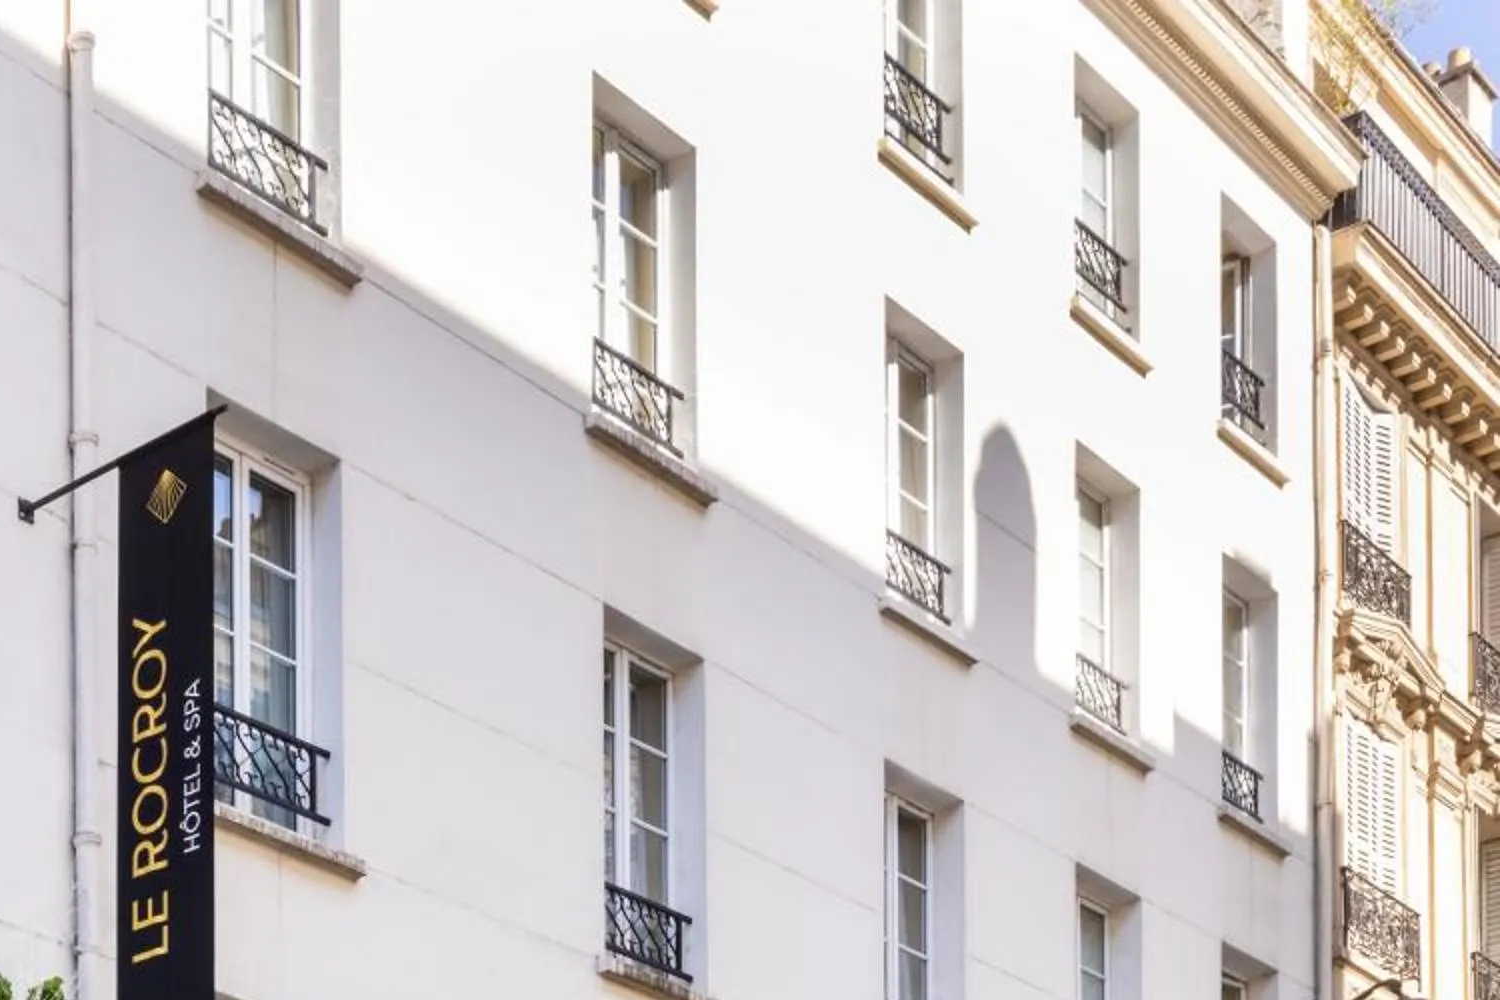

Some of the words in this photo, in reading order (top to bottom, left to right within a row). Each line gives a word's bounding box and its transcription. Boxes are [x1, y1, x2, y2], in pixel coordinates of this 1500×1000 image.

[183, 677, 201, 731] SPA
[131, 617, 169, 879] ROCROY
[183, 736, 201, 759] &
[179, 764, 201, 853] HÔTEL
[131, 890, 169, 964] LE
